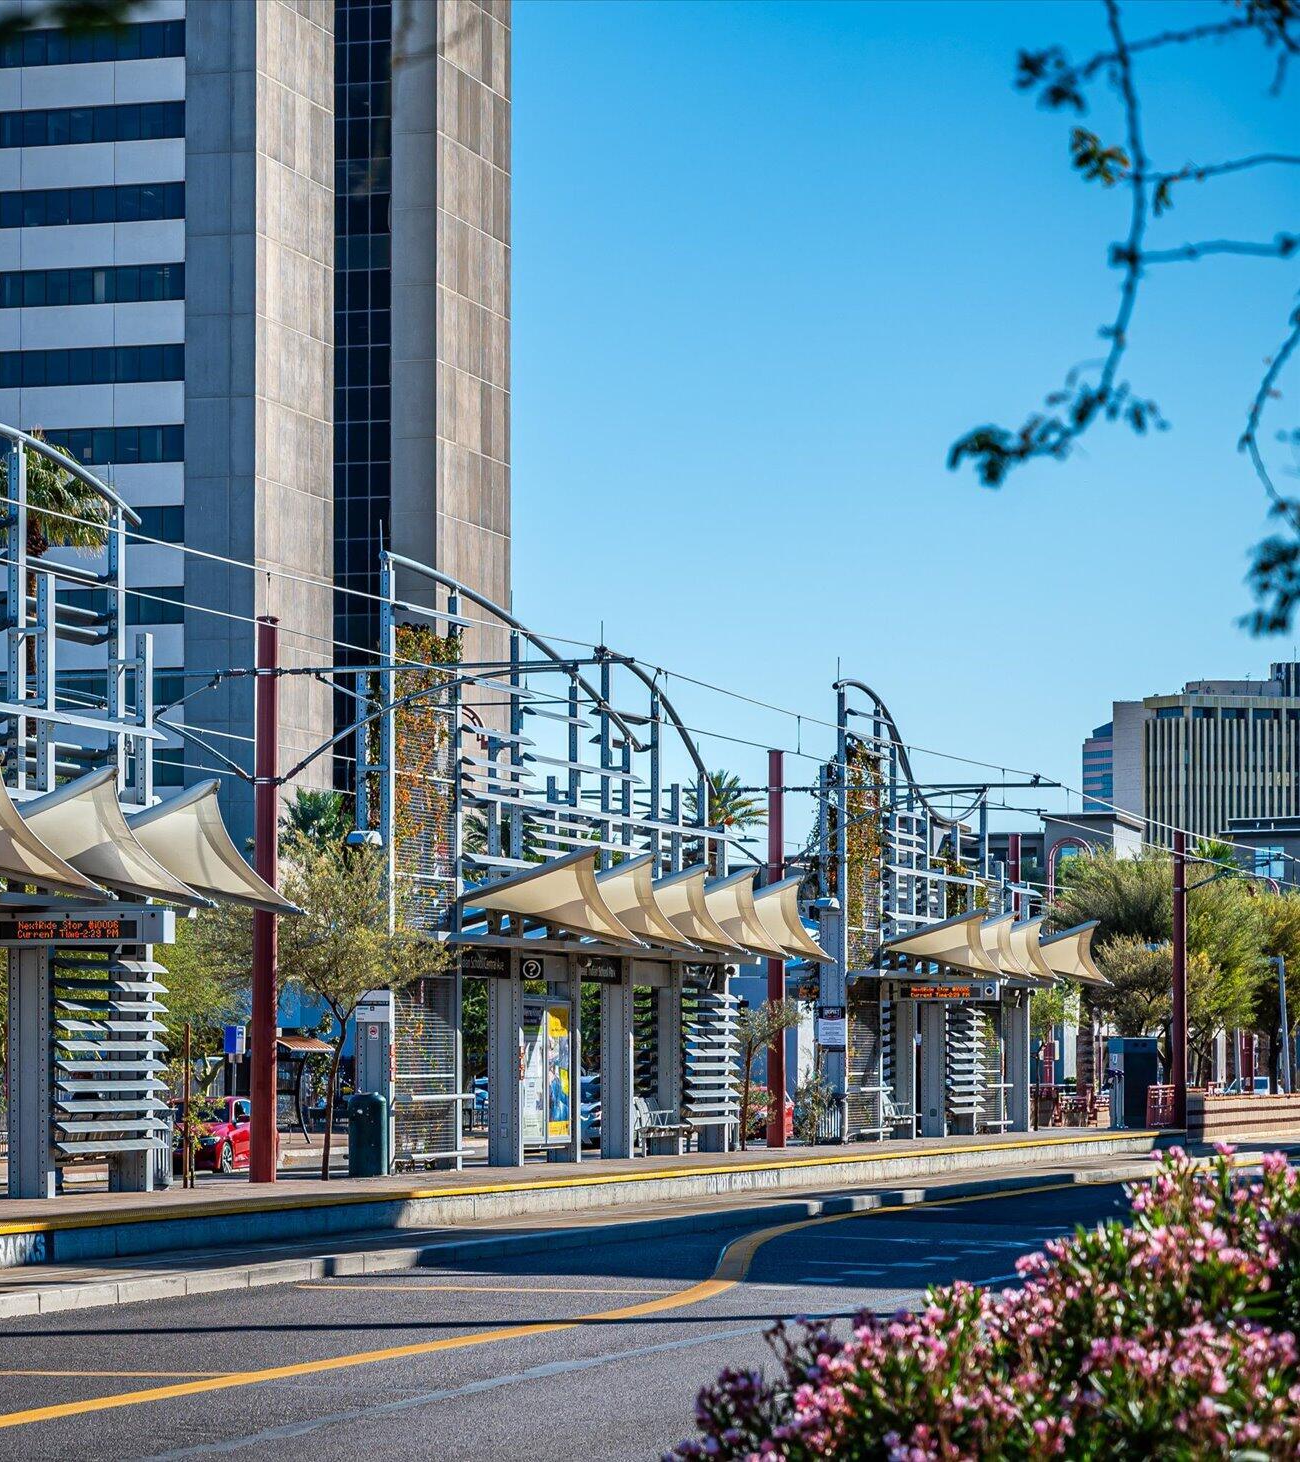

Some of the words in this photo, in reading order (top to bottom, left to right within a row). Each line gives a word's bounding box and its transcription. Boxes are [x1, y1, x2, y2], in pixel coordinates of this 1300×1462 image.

[61, 920, 83, 930] Stop
[17, 929, 54, 939] Current
[106, 928, 119, 938] PM
